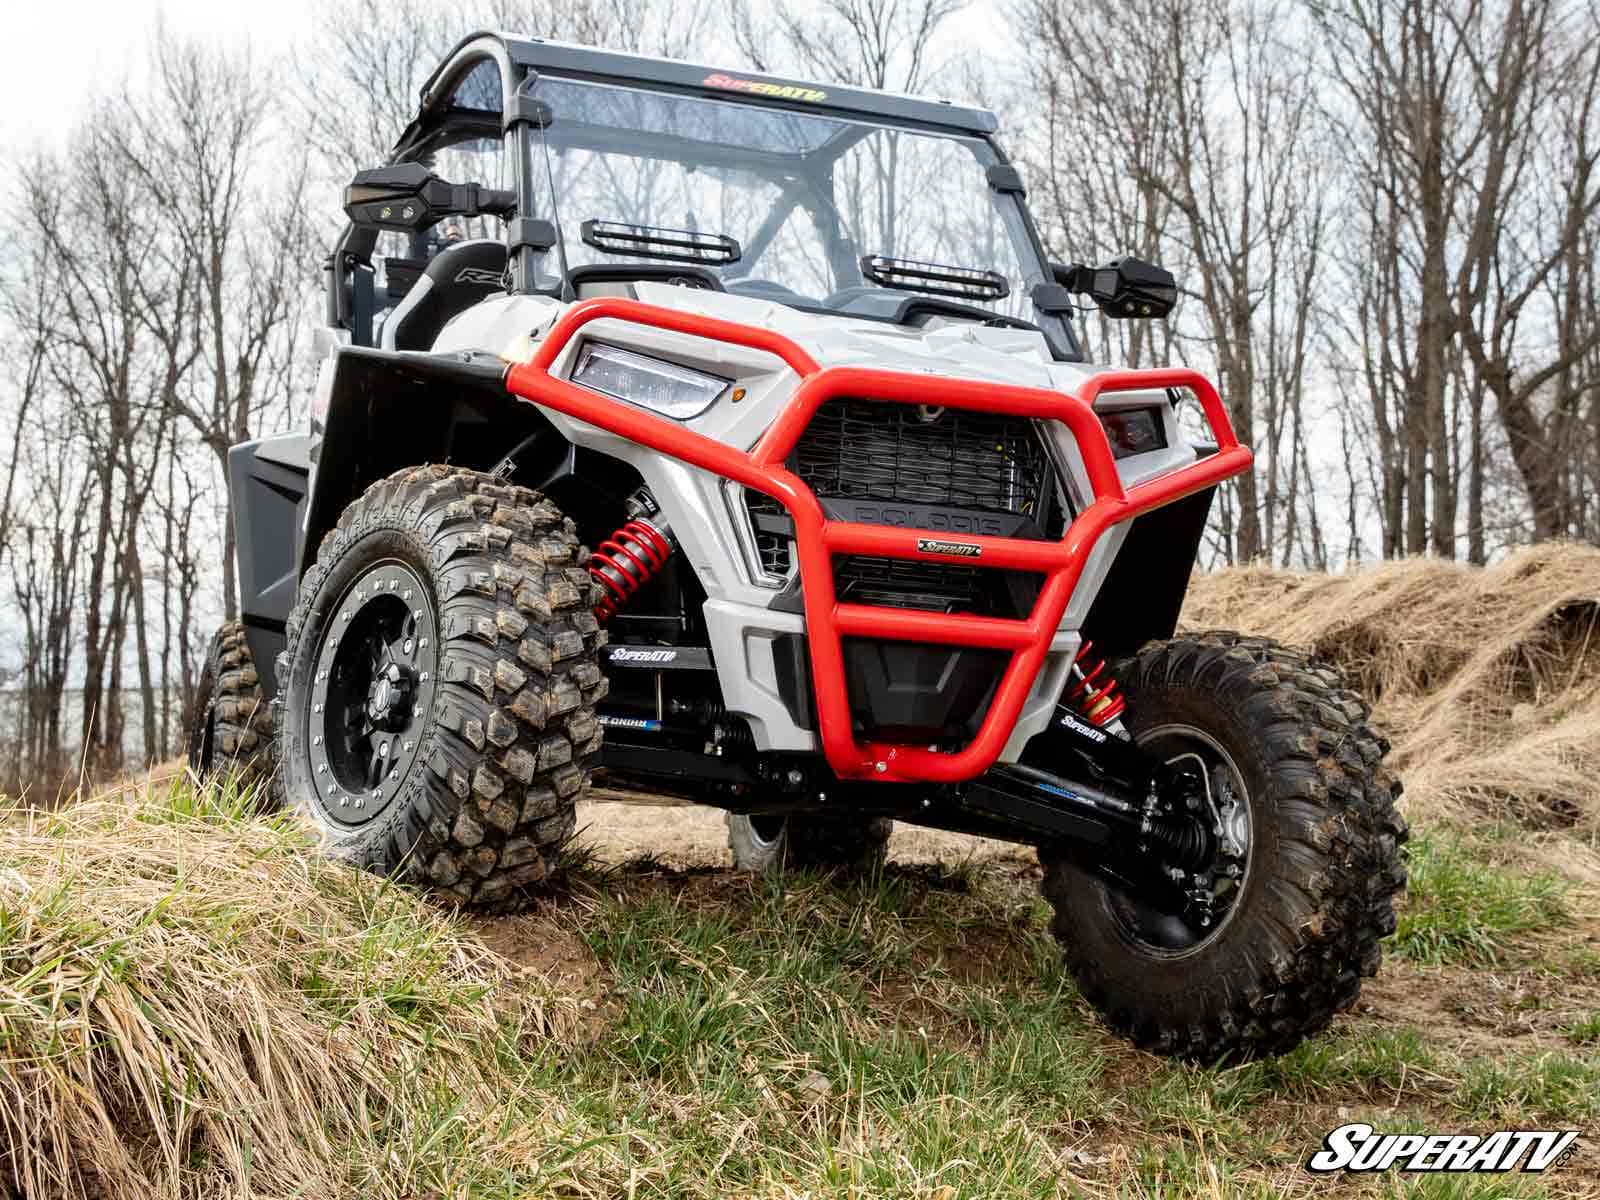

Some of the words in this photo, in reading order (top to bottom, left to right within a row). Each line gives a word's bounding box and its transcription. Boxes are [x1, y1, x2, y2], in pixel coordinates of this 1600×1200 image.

[855, 506, 1001, 537] POLARIS
[609, 647, 677, 662] SUPERATV
[1061, 715, 1107, 742] SUPERATV
